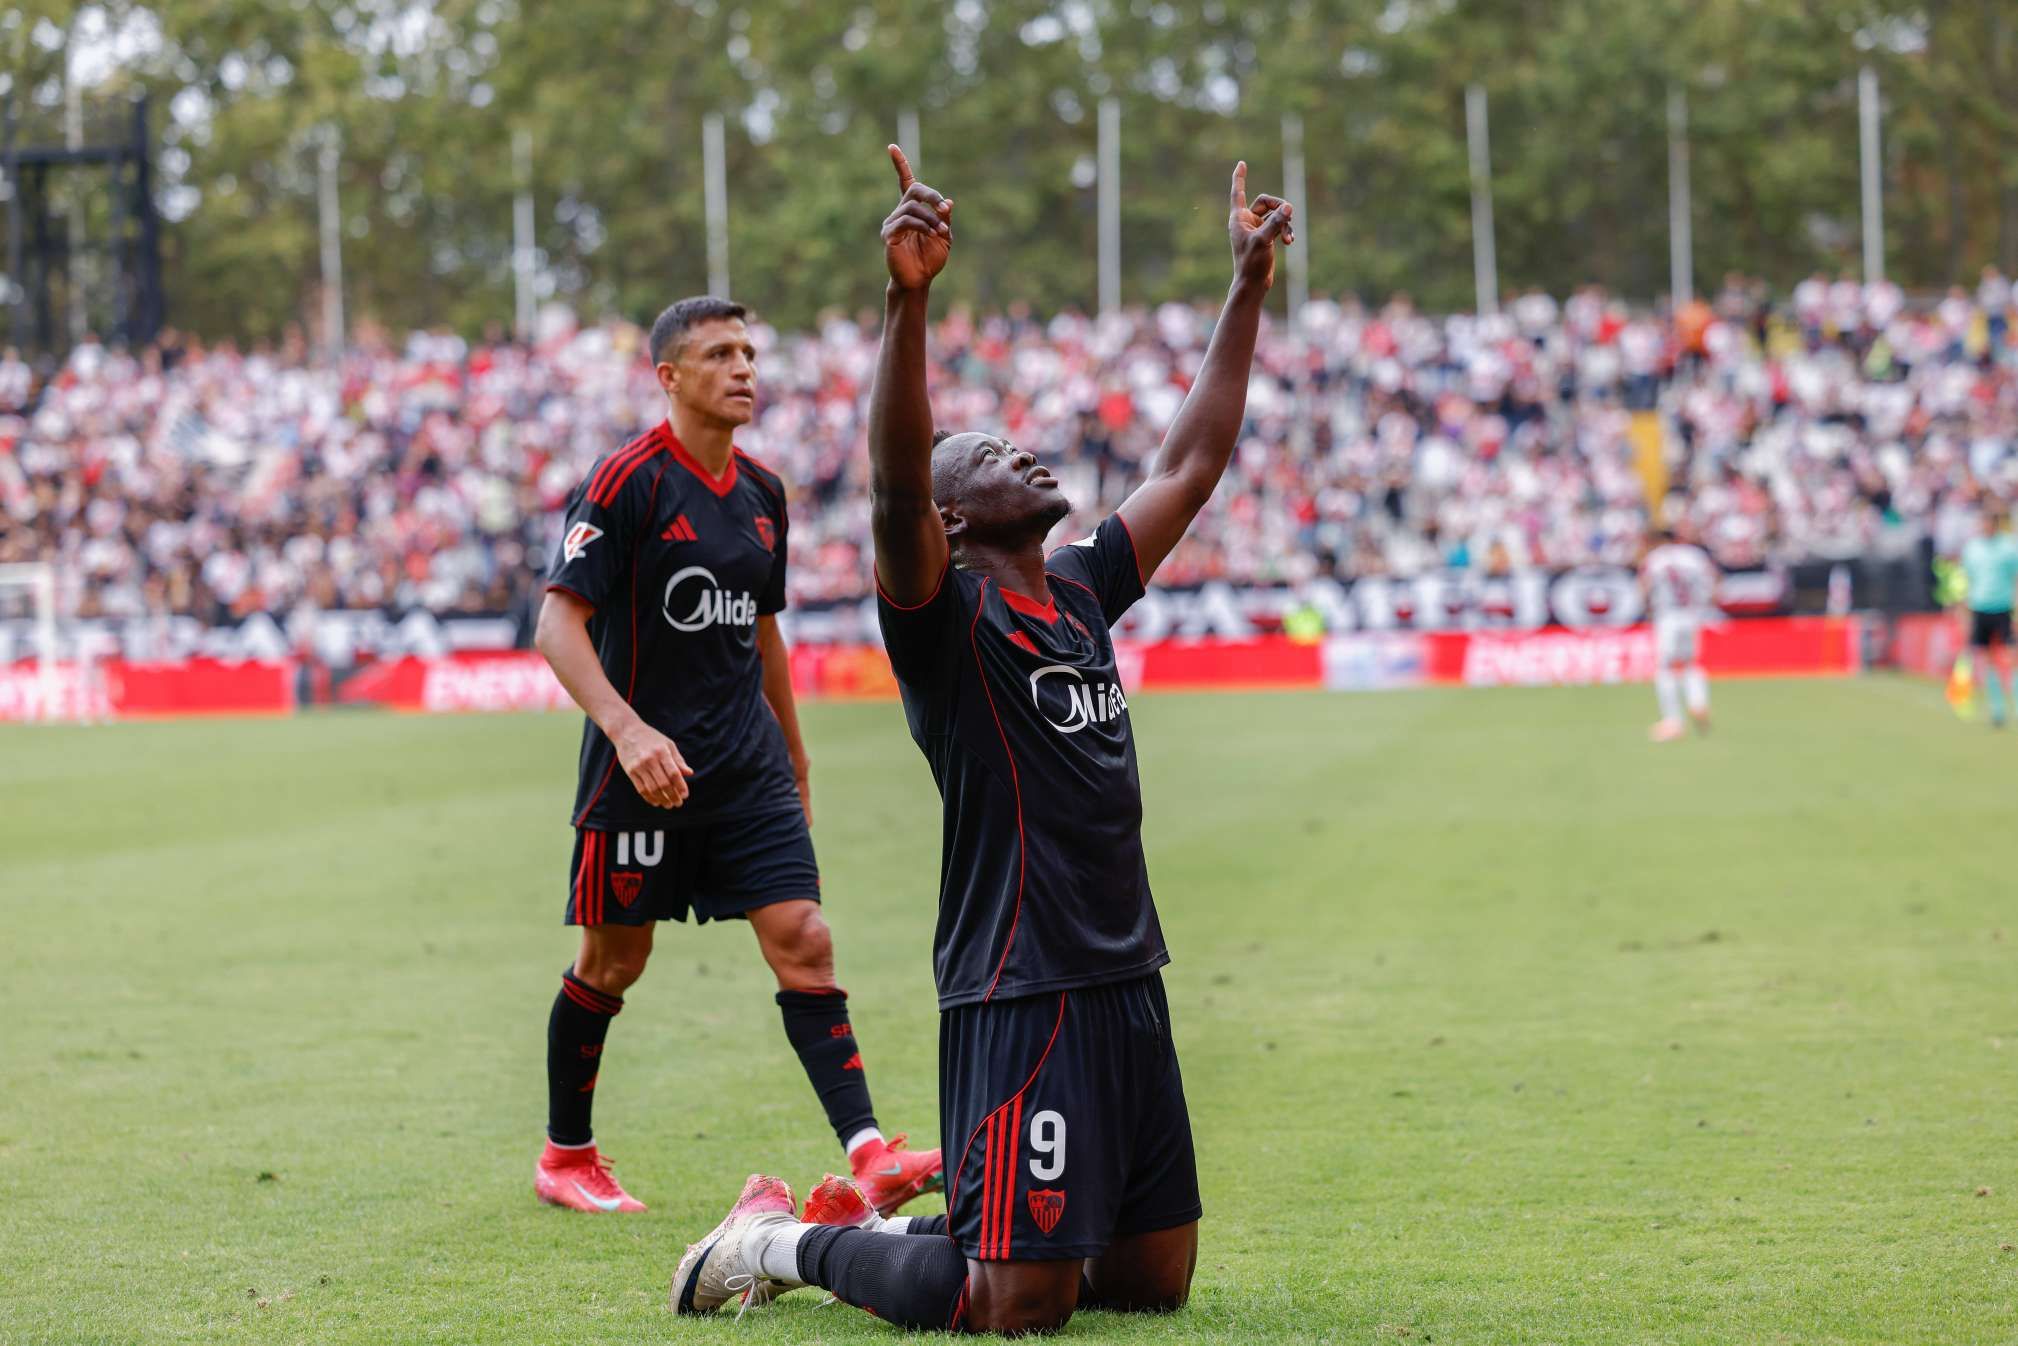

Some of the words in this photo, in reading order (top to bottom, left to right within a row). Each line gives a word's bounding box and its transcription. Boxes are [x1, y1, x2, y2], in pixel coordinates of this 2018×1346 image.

[662, 587, 758, 632] Mide
[1037, 682, 1128, 733] Midea
[830, 1023, 852, 1039] SF
[1029, 1109, 1067, 1181] 9
